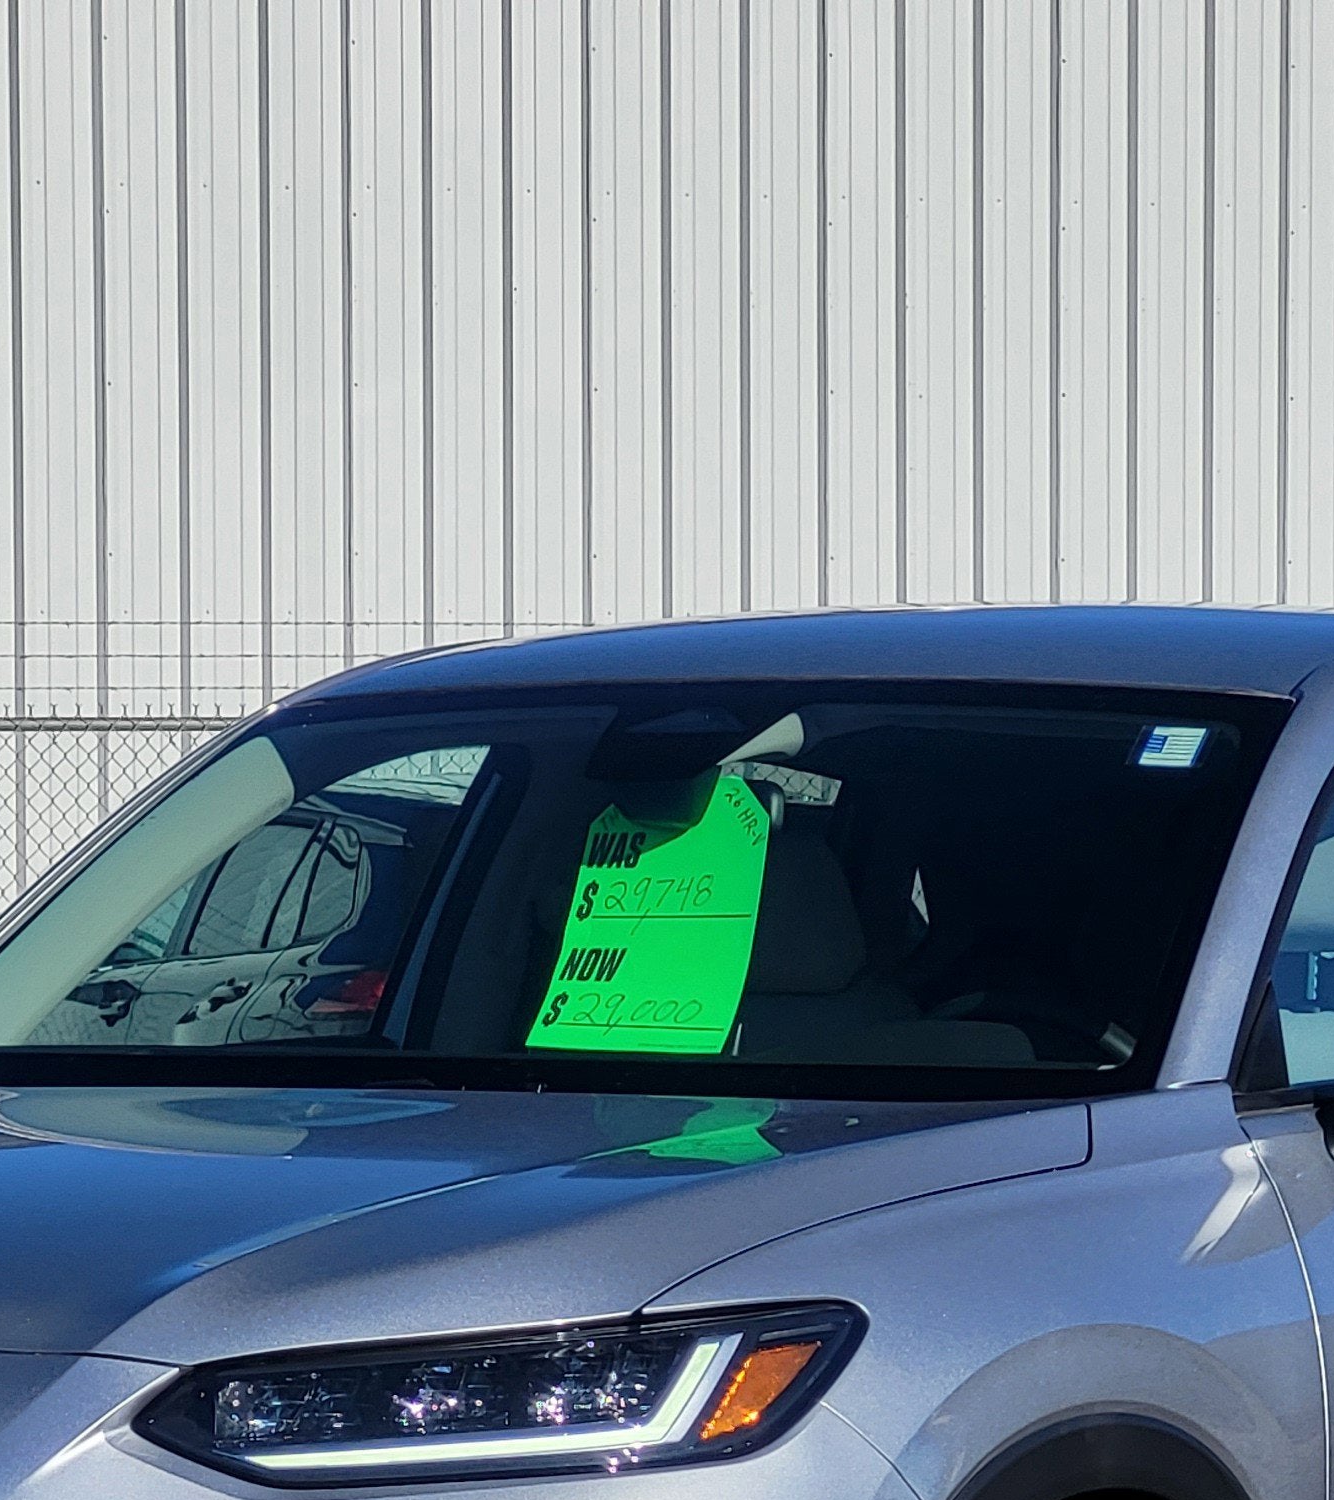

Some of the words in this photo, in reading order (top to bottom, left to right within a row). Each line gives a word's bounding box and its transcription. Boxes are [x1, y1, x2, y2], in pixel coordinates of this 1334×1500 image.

[587, 832, 647, 868] WAS
[558, 948, 628, 982] NOW
[572, 993, 703, 1037] 29,000
